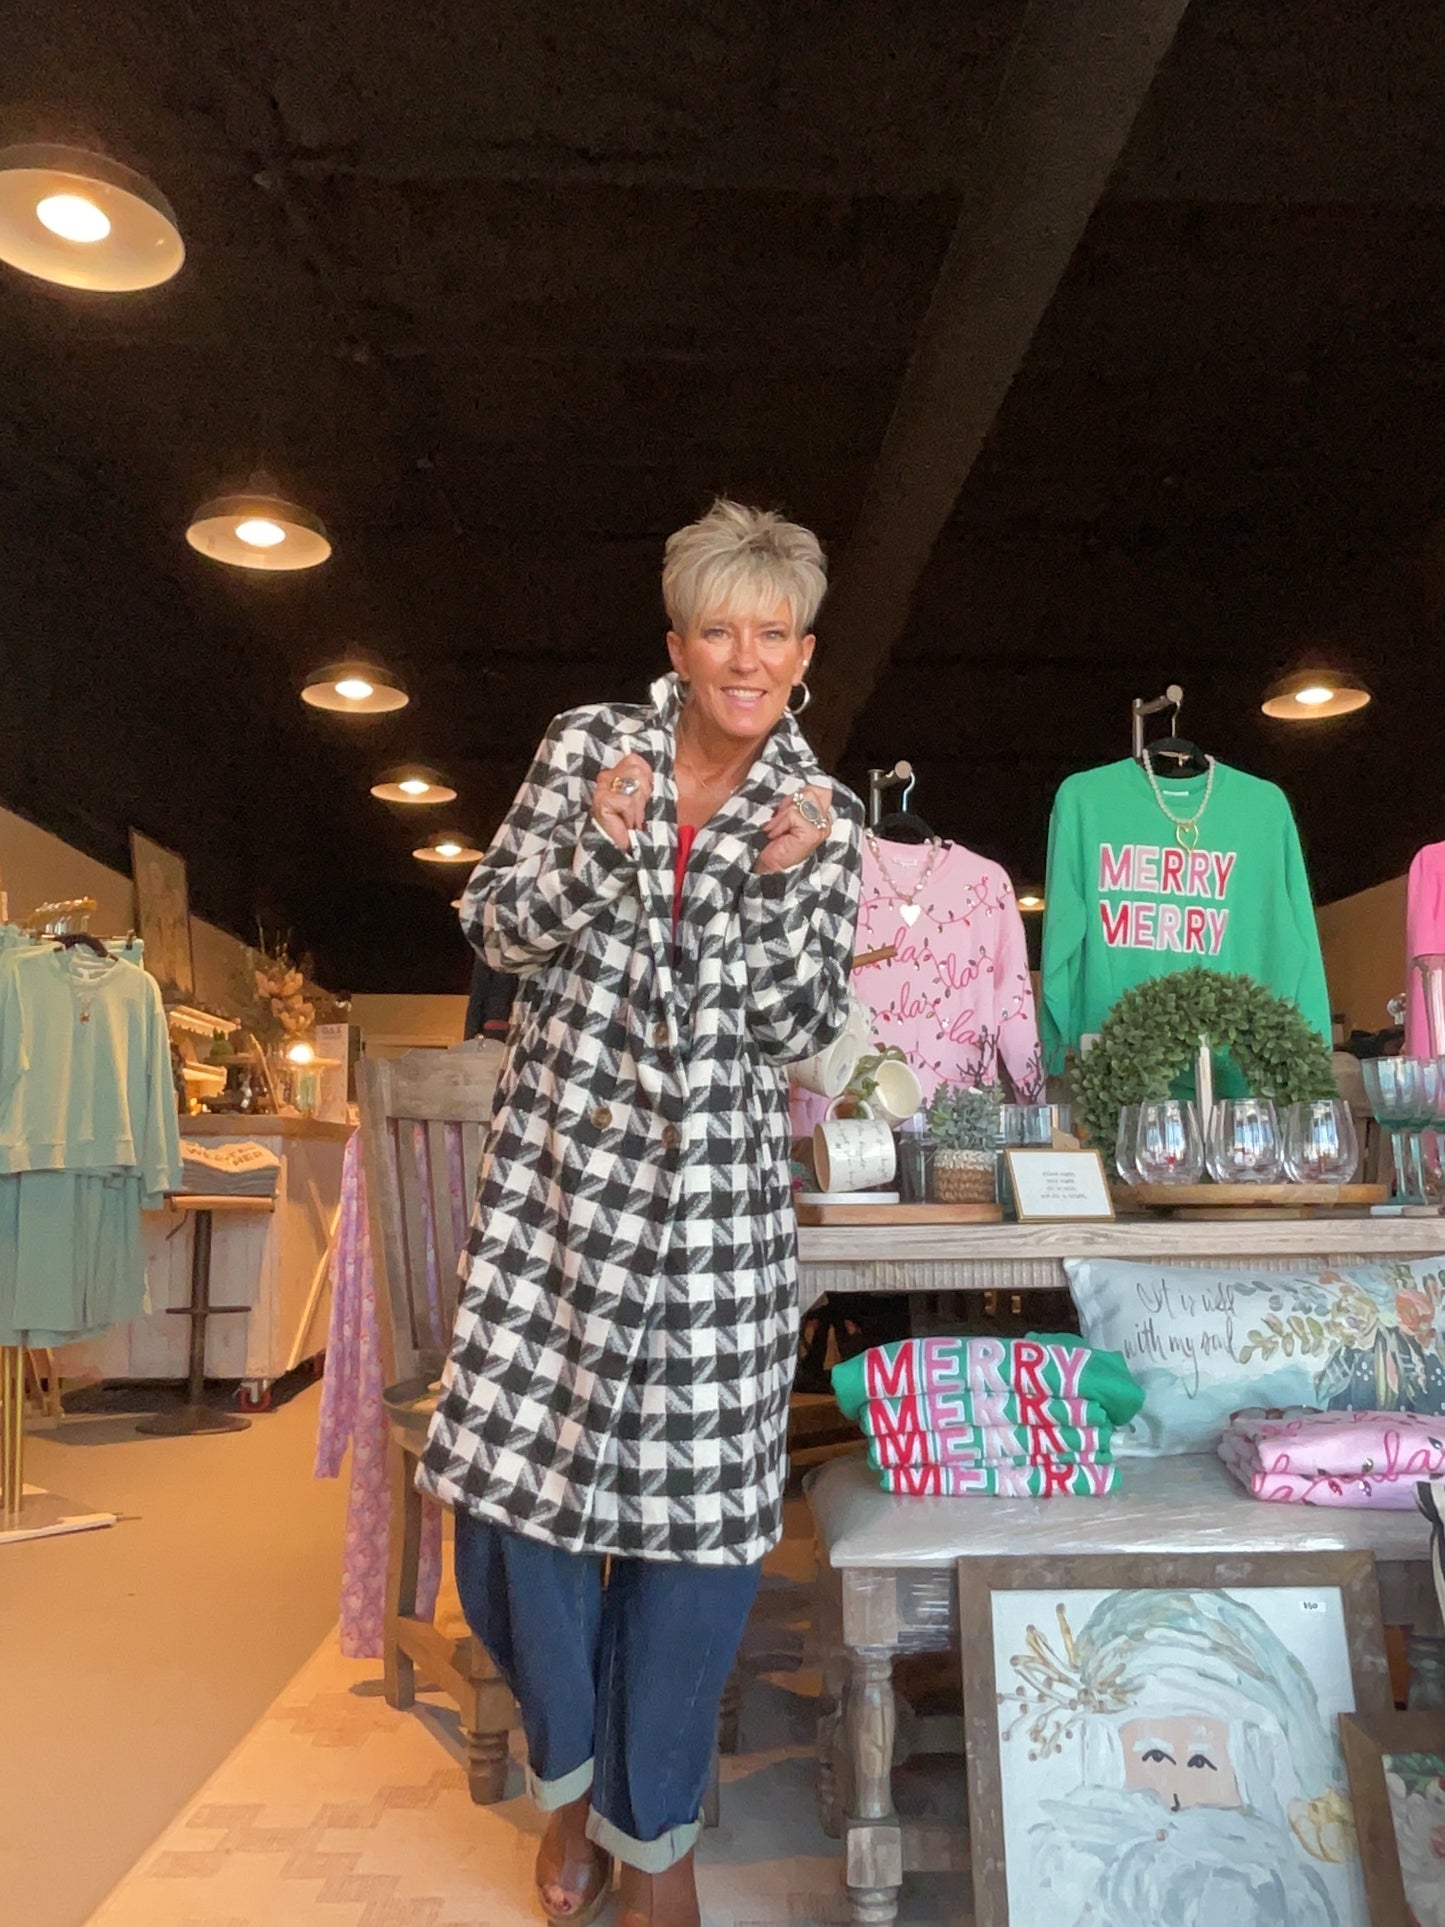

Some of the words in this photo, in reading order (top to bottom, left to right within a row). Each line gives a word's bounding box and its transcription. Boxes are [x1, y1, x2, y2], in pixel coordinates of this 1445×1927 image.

[1098, 843, 1236, 900] MERRY
[1099, 900, 1230, 956] MERRY
[1136, 1278, 1175, 1319] It
[864, 1338, 1092, 1401] MERRY
[1123, 1317, 1167, 1361] with
[1168, 1335, 1199, 1400] my
[1200, 1316, 1240, 1363] soul
